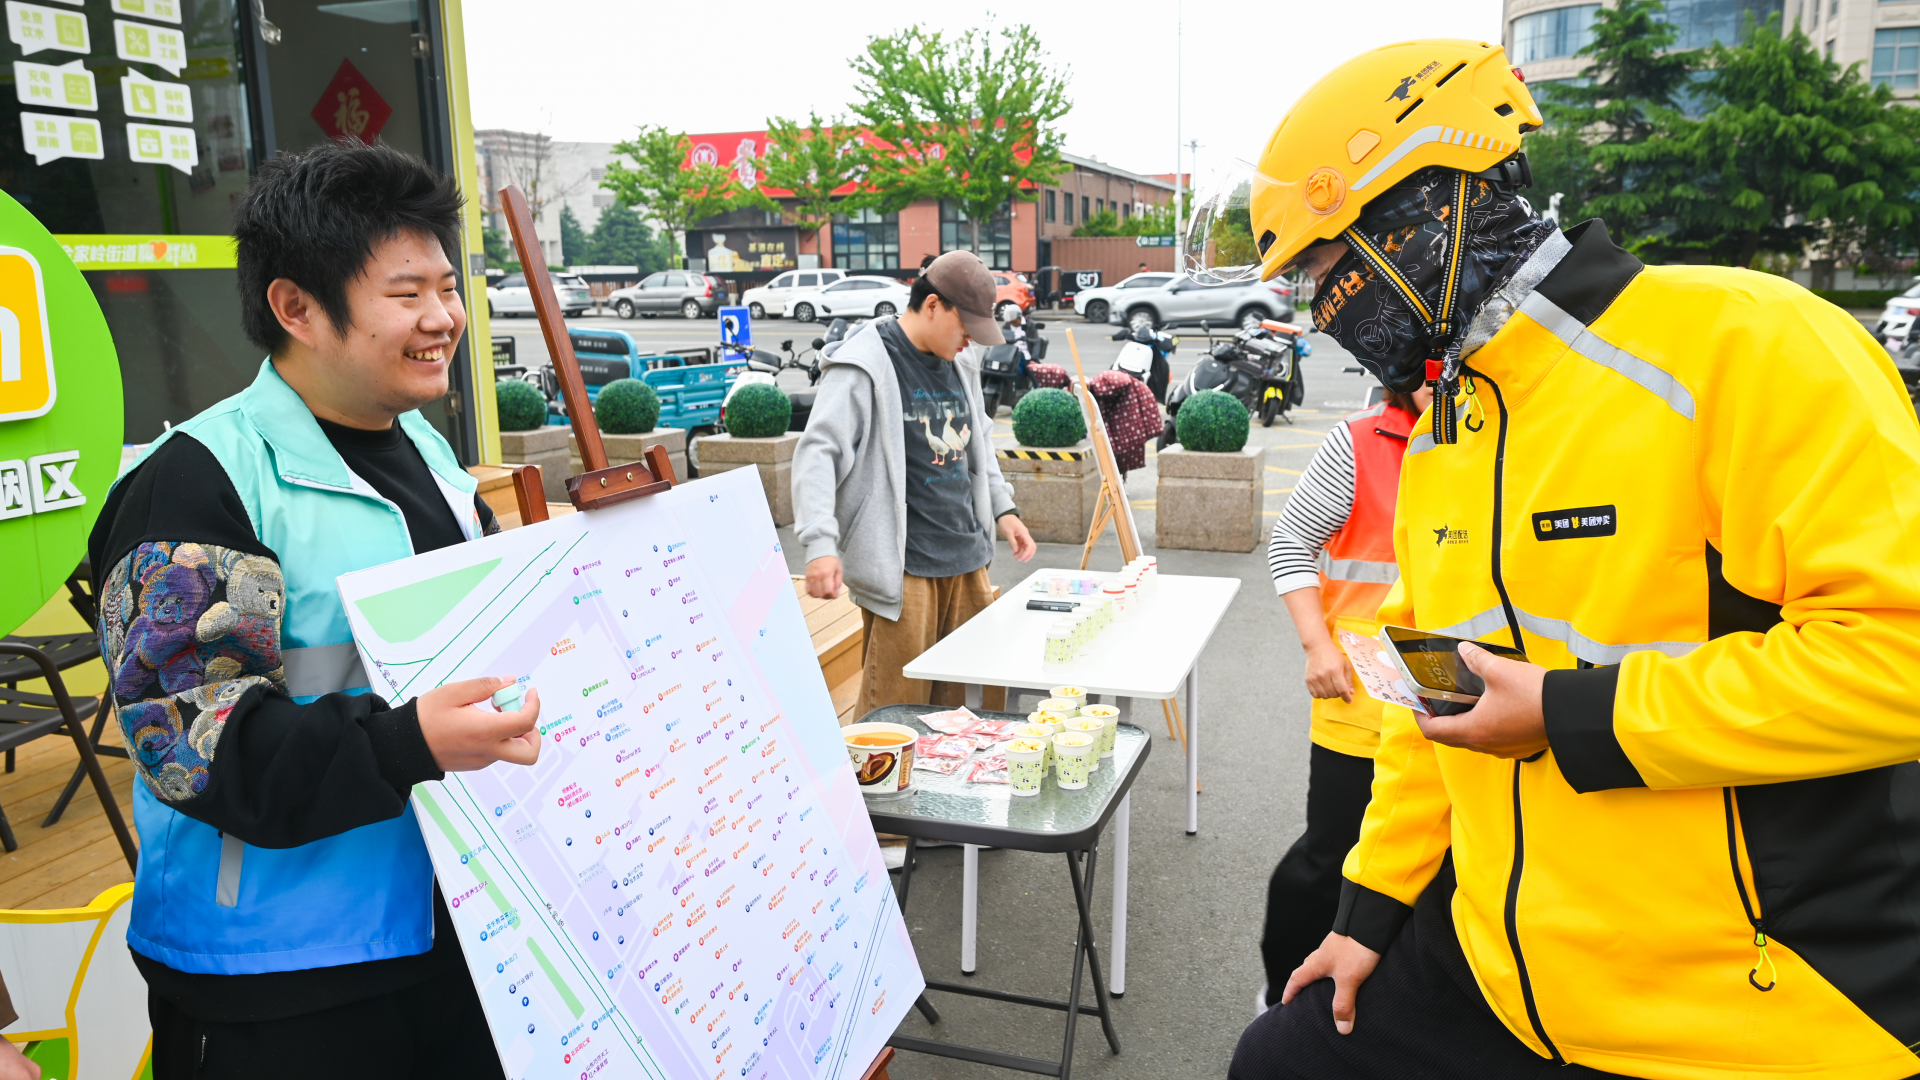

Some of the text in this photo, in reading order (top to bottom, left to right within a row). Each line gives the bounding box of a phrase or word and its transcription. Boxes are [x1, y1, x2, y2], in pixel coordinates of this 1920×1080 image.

[20, 10, 43, 24] 免费
[22, 26, 45, 39] 饮水
[160, 48, 178, 60] 工具
[28, 69, 52, 84] 充电
[30, 85, 53, 99] 换电
[166, 104, 185, 116] 休息
[333, 86, 370, 134] 福
[1554, 519, 1570, 529] 美团
[1581, 515, 1610, 527] 美团外卖
[1418, 644, 1452, 687] 09:32
[502, 799, 516, 810] 西北门
[503, 953, 517, 967] 东北门
[515, 970, 534, 987] 兴业银行
